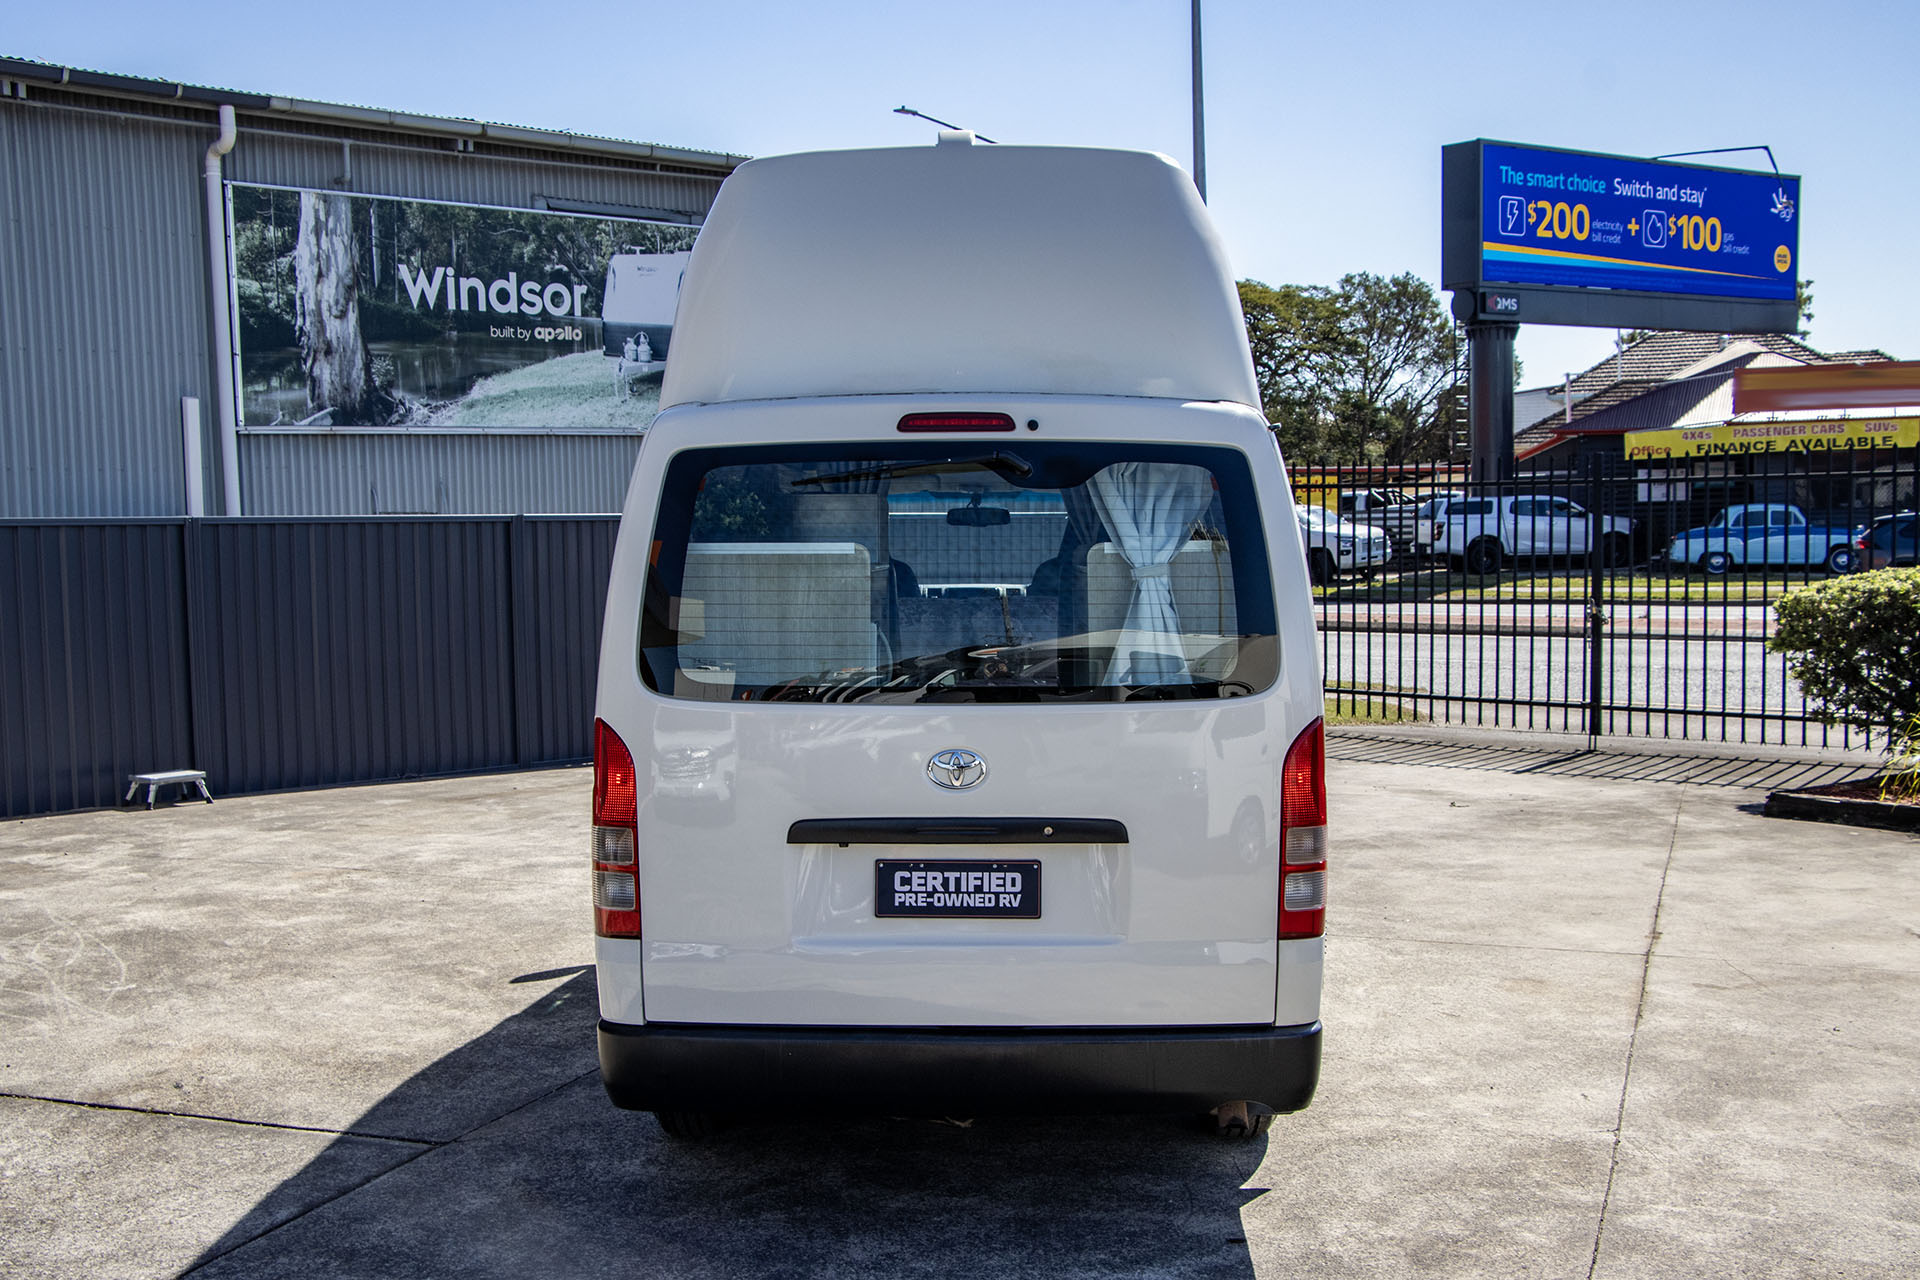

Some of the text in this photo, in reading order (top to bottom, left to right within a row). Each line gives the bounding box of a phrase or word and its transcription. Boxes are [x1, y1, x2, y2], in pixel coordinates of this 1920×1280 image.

[1500, 165, 1606, 193] The smart choice
[1614, 177, 1654, 199] Switch
[1656, 184, 1678, 201] and
[1527, 200, 1590, 241] $200
[1668, 213, 1722, 252] $100
[398, 263, 588, 317] Windsor
[490, 325, 583, 343] built by apollo
[1733, 425, 1807, 438] PASSENGER
[1811, 424, 1845, 435] CARS
[1864, 422, 1898, 432] SUVs
[1631, 445, 1672, 456] Office
[1696, 435, 1893, 454] FINANCE AVAILABLE
[894, 871, 1022, 893] CERTIFIED
[894, 893, 1022, 908] PRE-OWNED RV
